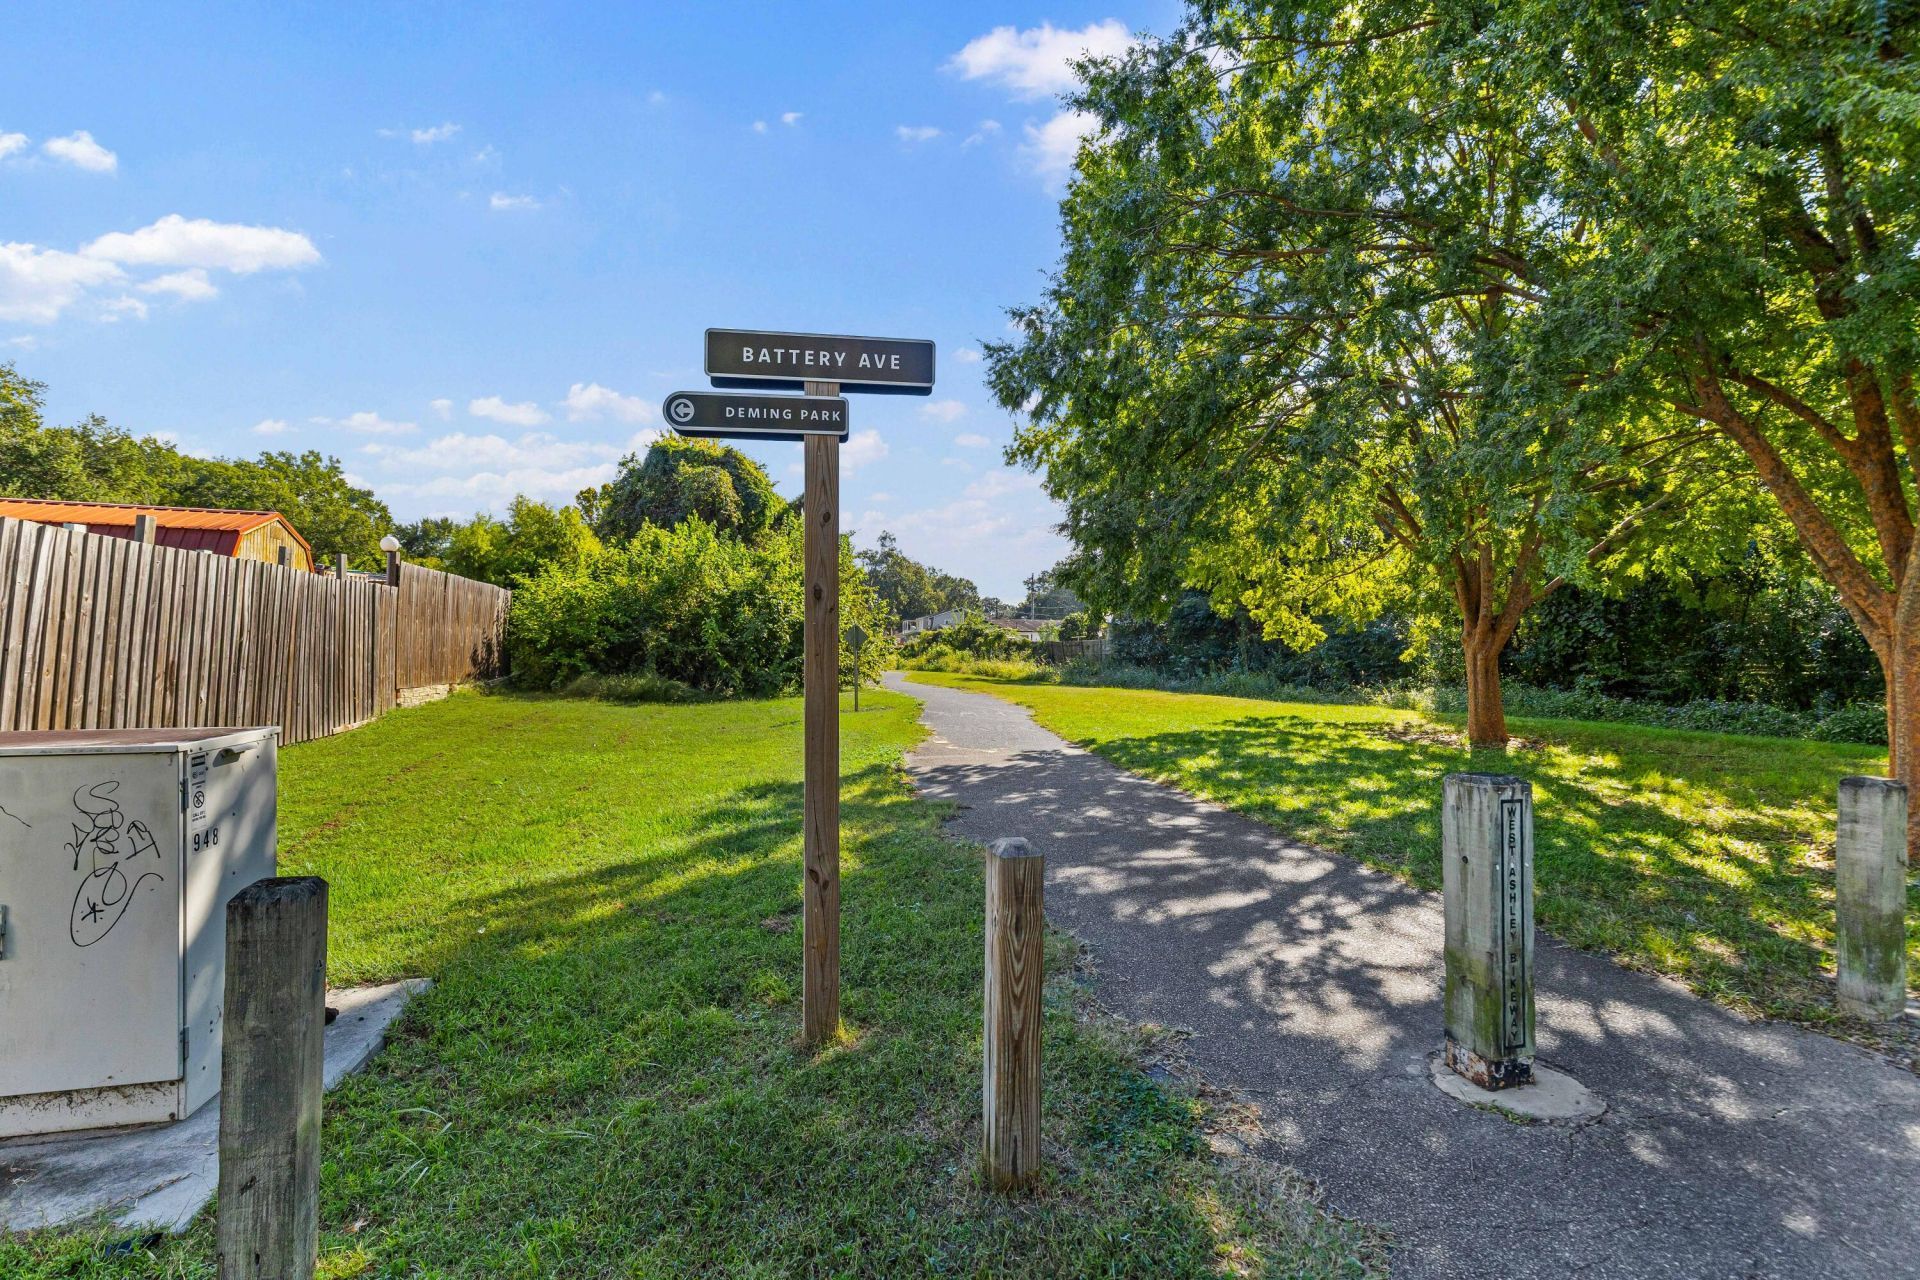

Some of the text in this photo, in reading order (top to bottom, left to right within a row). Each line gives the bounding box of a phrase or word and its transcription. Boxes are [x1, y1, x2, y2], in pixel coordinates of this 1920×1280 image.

[742, 346, 901, 370] BATTERY AVE
[725, 406, 841, 422] DEMING PARK
[193, 828, 219, 852] 948
[1507, 806, 1518, 1041] WEST ASHLEY BIKEWAY
